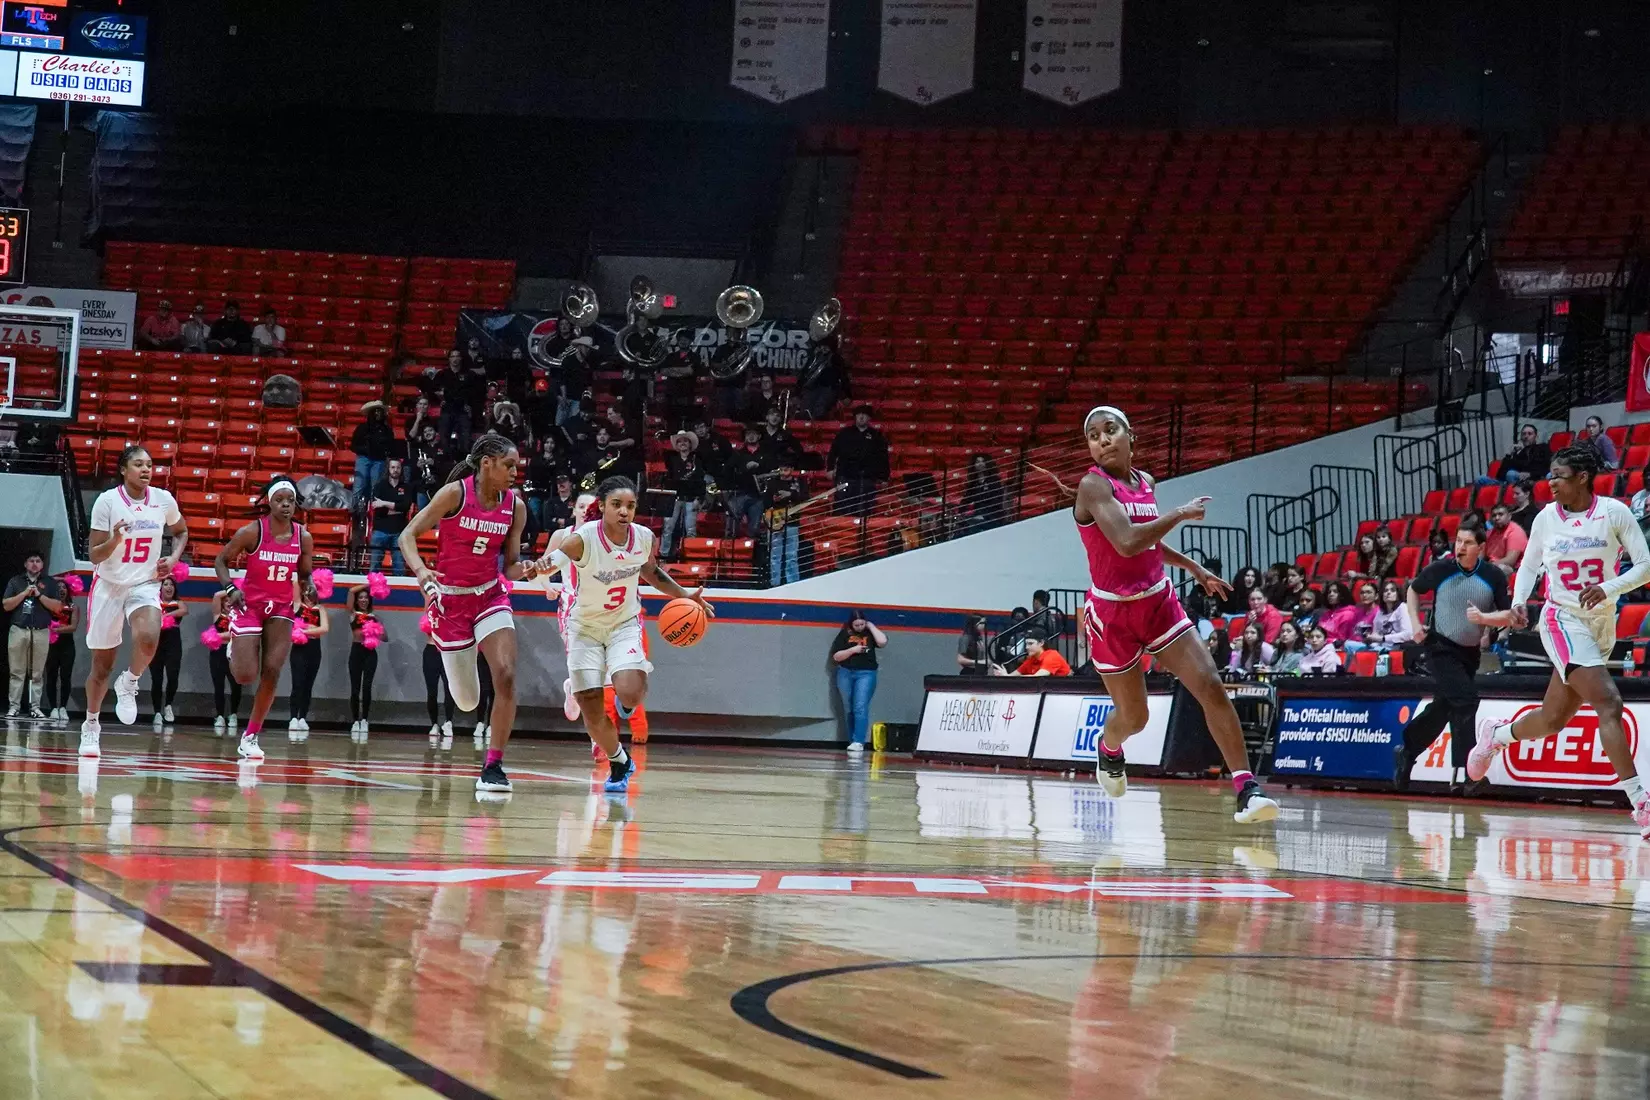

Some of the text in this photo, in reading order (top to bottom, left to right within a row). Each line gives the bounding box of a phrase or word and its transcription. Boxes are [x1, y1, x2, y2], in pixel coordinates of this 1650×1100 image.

[97, 21, 131, 32] BUD
[11, 36, 50, 48] FLS 1
[89, 30, 134, 41] LIGHT
[42, 55, 121, 75] Charlie's
[32, 73, 131, 93] USED CARS
[49, 91, 71, 101] (936)
[82, 299, 107, 309] EVERY
[746, 329, 810, 349] FOR
[459, 516, 476, 530] SAM
[121, 537, 153, 563] 15
[472, 536, 490, 555] 5
[258, 549, 273, 562] SAM
[267, 565, 289, 582] 12
[1557, 558, 1605, 591] 23
[603, 586, 627, 610] 3
[664, 621, 692, 643] Wilson
[942, 695, 998, 718] MEMORIAL
[939, 714, 995, 733] HERMANN
[1283, 708, 1369, 725] The Official Internet
[1279, 726, 1391, 744] provider of SHSU Athletics
[977, 738, 1010, 755] Orthopedics
[1274, 756, 1306, 770] optimum
